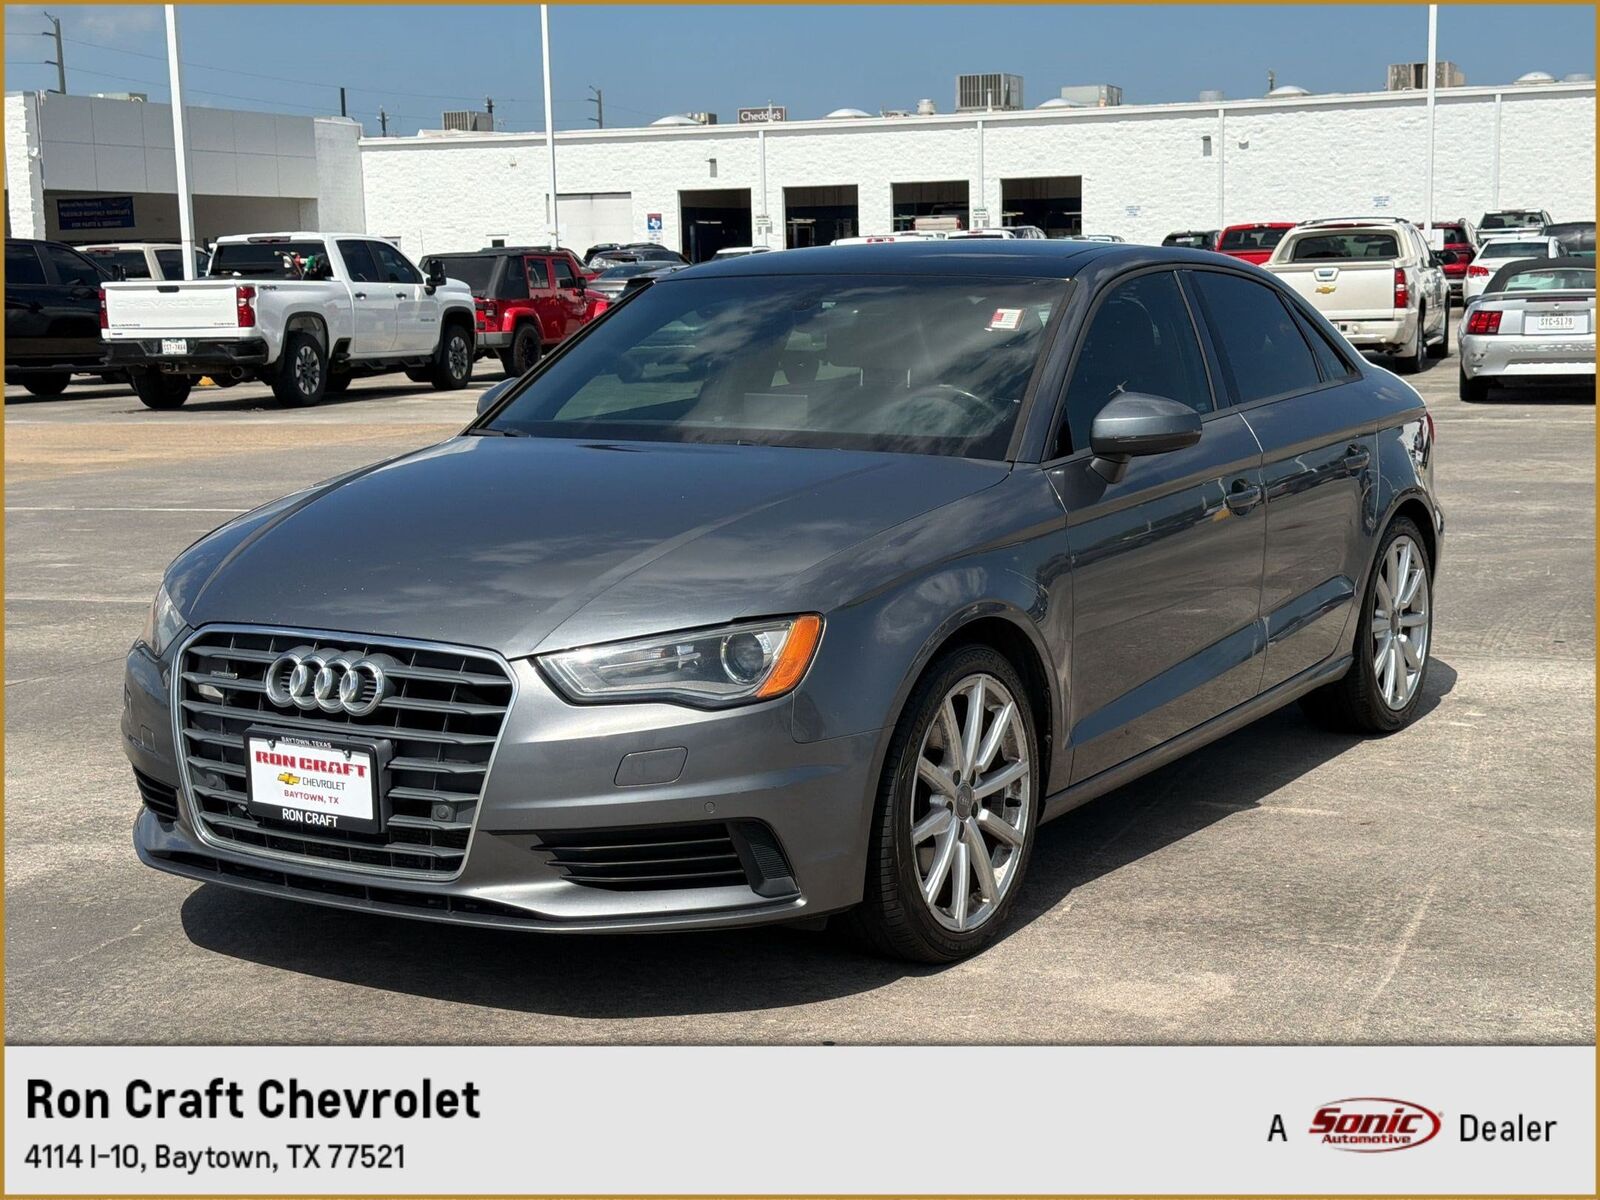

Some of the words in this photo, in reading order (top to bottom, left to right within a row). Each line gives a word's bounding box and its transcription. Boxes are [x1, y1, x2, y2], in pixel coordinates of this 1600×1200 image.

[311, 740, 332, 749] TEXAS
[255, 750, 296, 768] RON
[299, 757, 367, 778] CRAFT
[302, 777, 346, 791] CHEVROLET
[284, 789, 327, 804] BAYTOWN,
[328, 796, 340, 805] TX
[282, 808, 304, 823] RON
[305, 811, 338, 828] CRAFT
